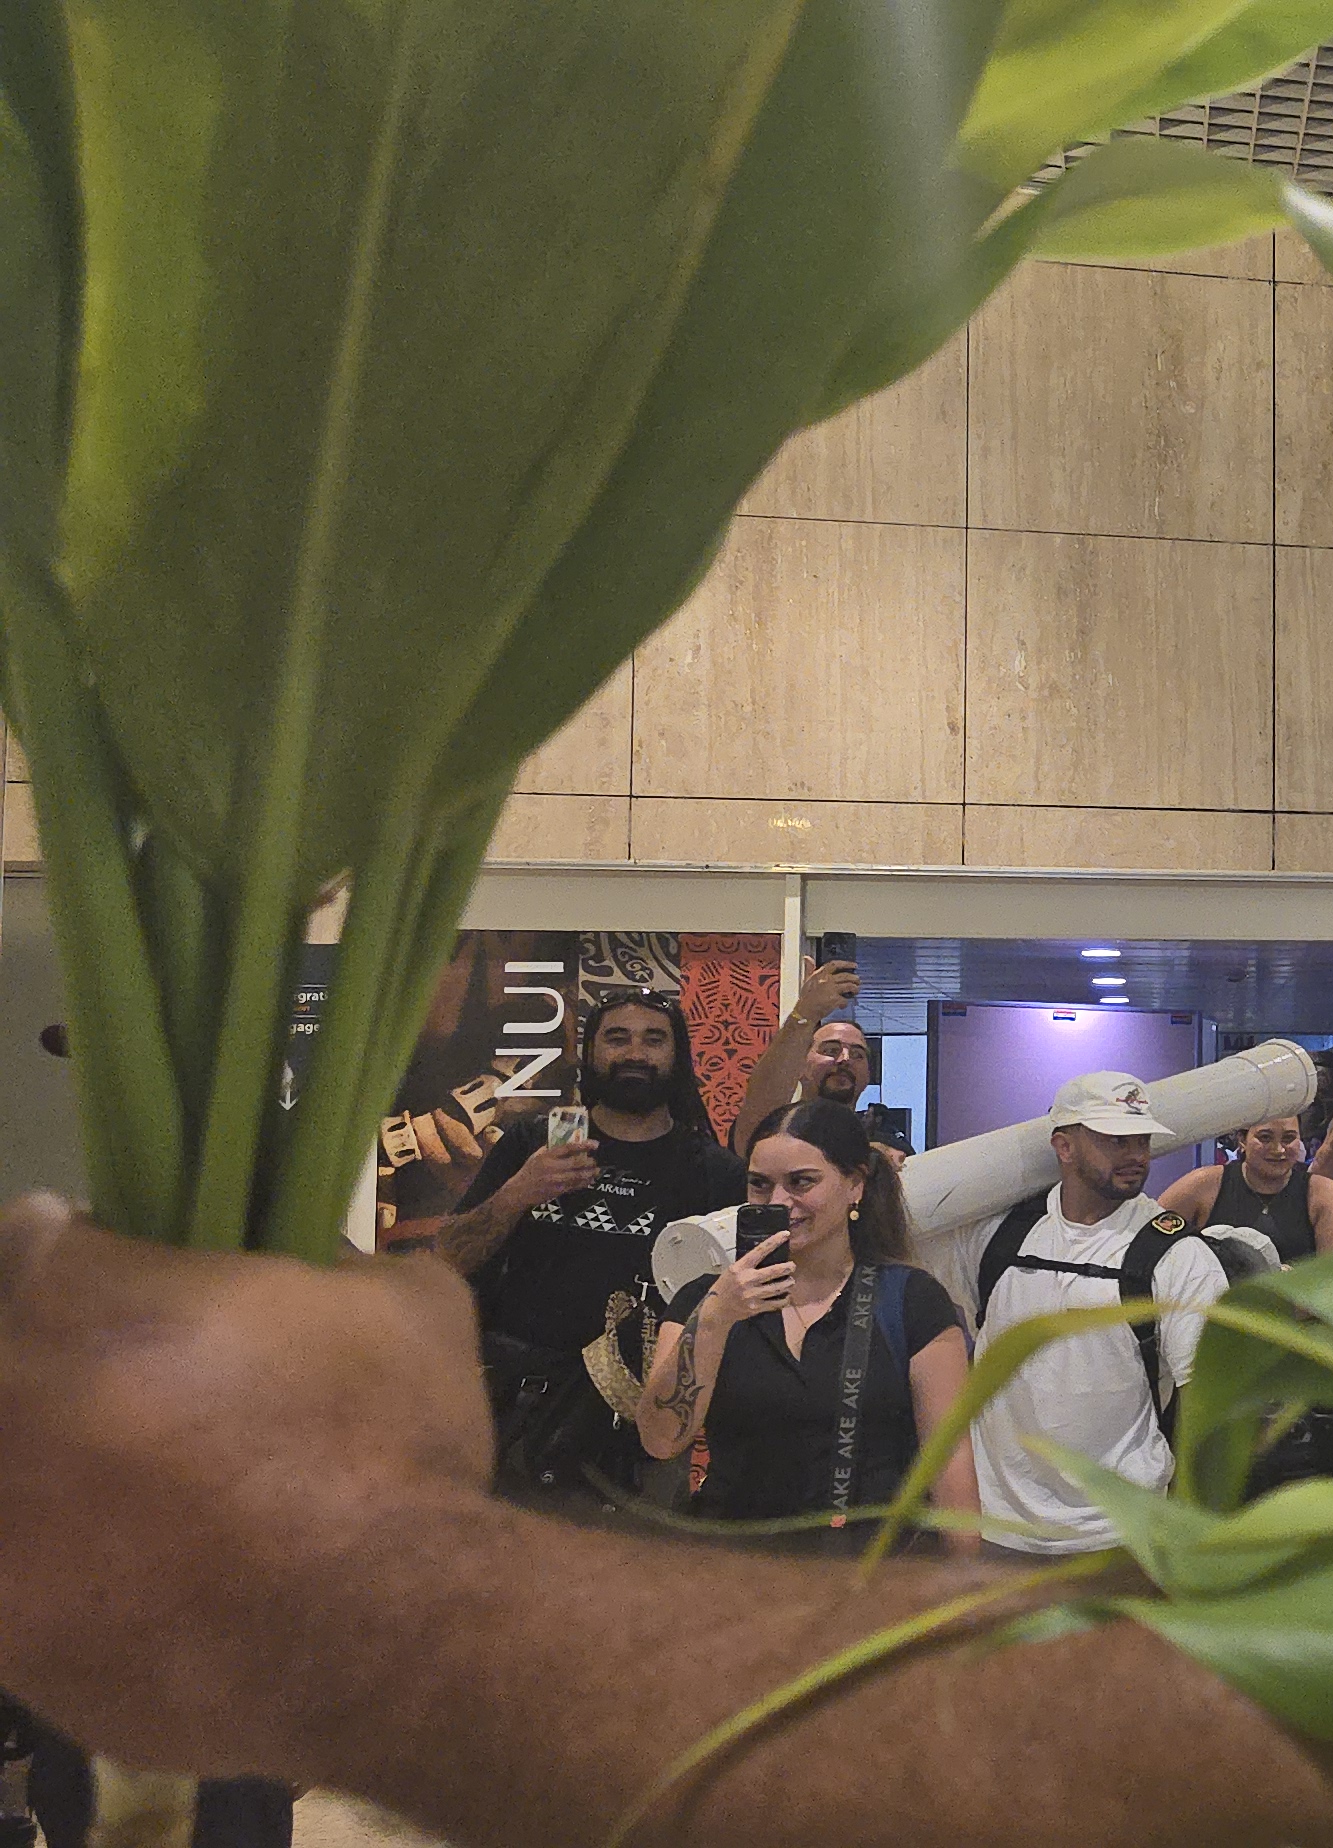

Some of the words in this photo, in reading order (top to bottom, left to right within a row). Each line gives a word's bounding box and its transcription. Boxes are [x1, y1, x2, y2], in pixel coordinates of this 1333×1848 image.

[494, 961, 565, 1099] NUI
[597, 1183, 635, 1197] ARAWA
[853, 1292, 873, 1330] AKE
[842, 1368, 862, 1410] AKE
[837, 1416, 857, 1459] AKE
[832, 1467, 851, 1511] AKE
